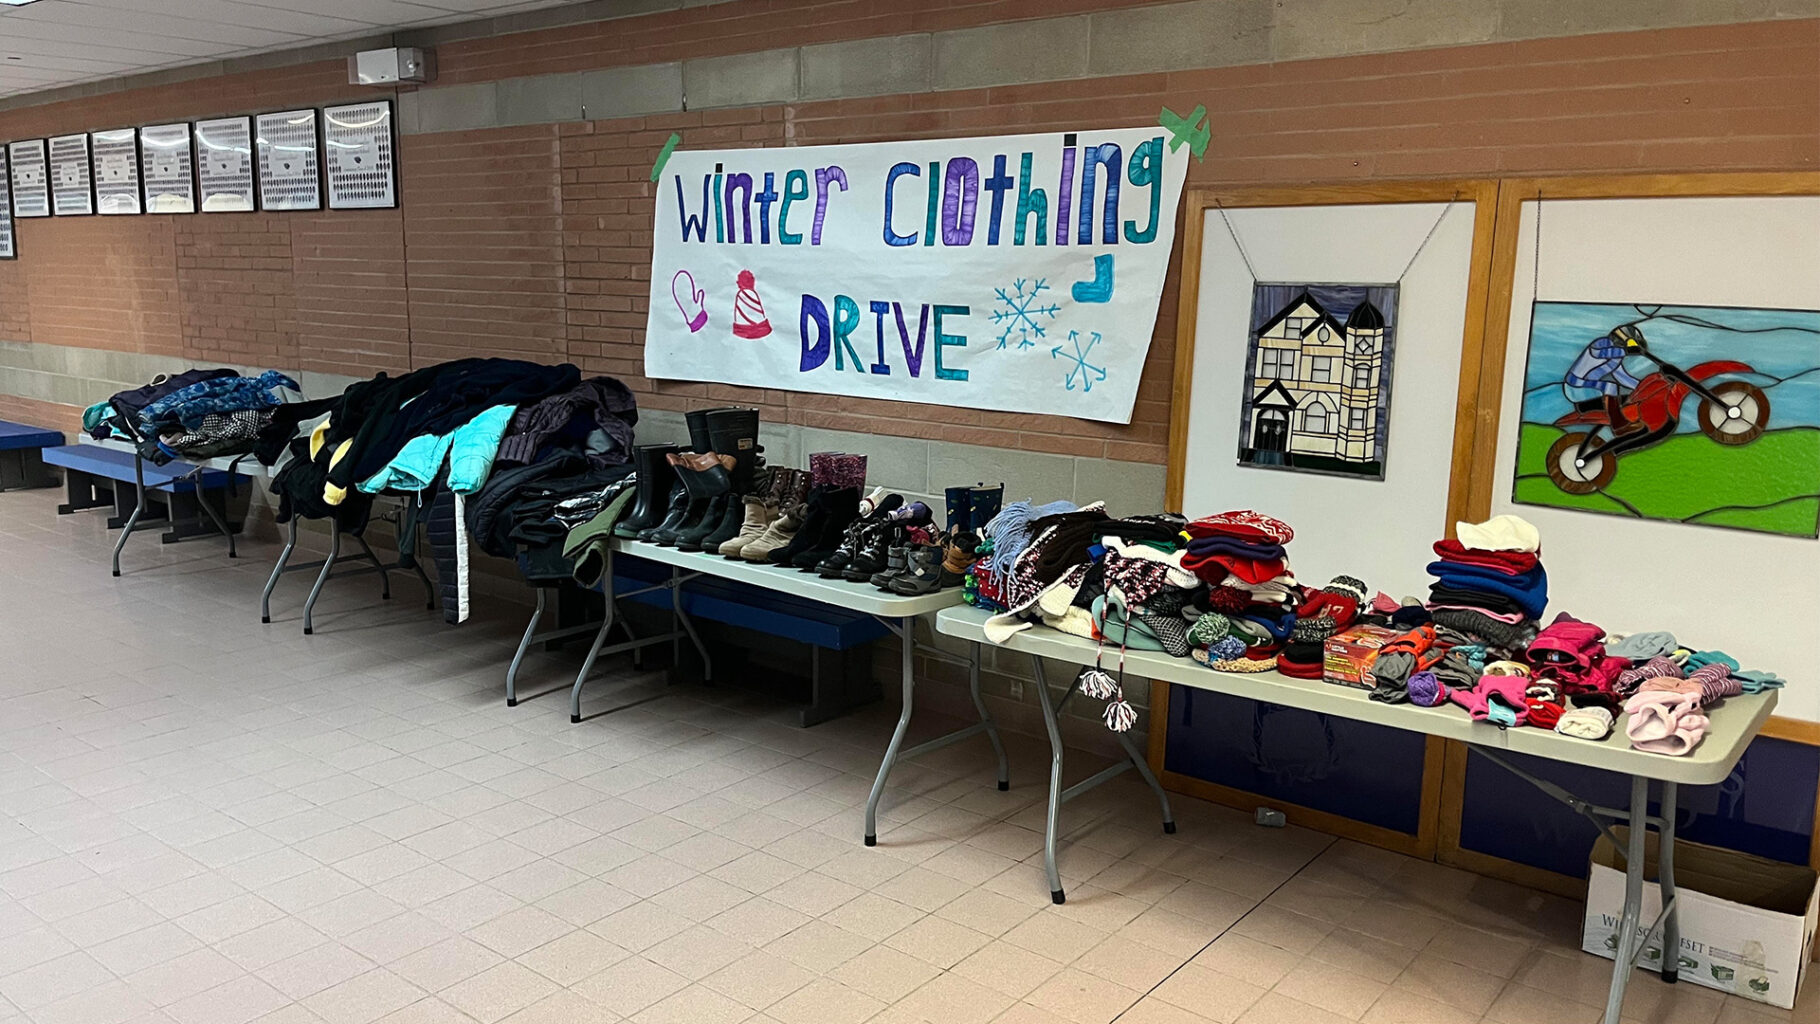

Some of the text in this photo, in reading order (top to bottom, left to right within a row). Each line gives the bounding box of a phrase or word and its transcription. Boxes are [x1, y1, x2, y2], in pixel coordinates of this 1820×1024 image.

[675, 133, 1164, 246] Winter Clothing
[800, 294, 971, 382] DRIVE
[1663, 931, 1706, 954] FSET
